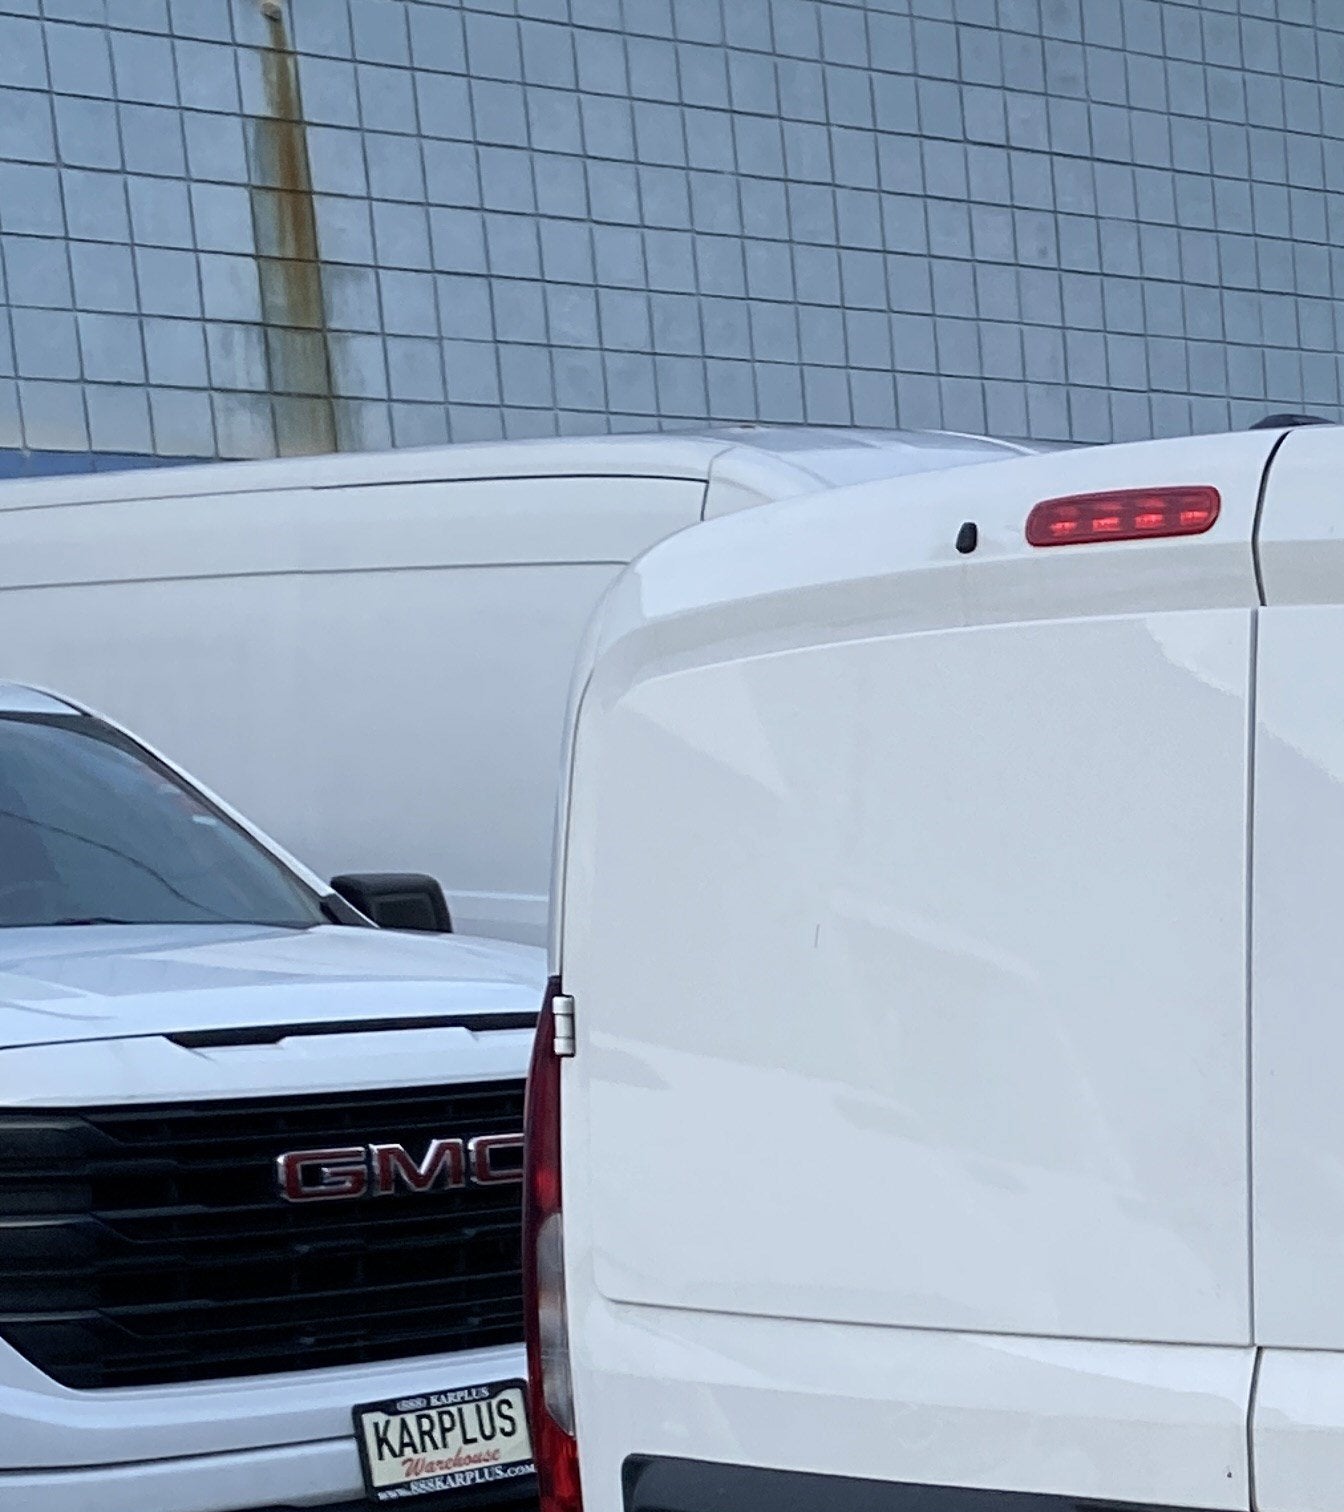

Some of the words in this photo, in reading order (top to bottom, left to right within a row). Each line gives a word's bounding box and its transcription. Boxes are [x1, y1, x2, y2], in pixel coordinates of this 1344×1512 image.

[277, 1133, 524, 1202] GMC
[430, 1387, 490, 1407] KARPLUS
[373, 1399, 516, 1461] KARPLUS
[402, 1446, 501, 1478] Warehouse
